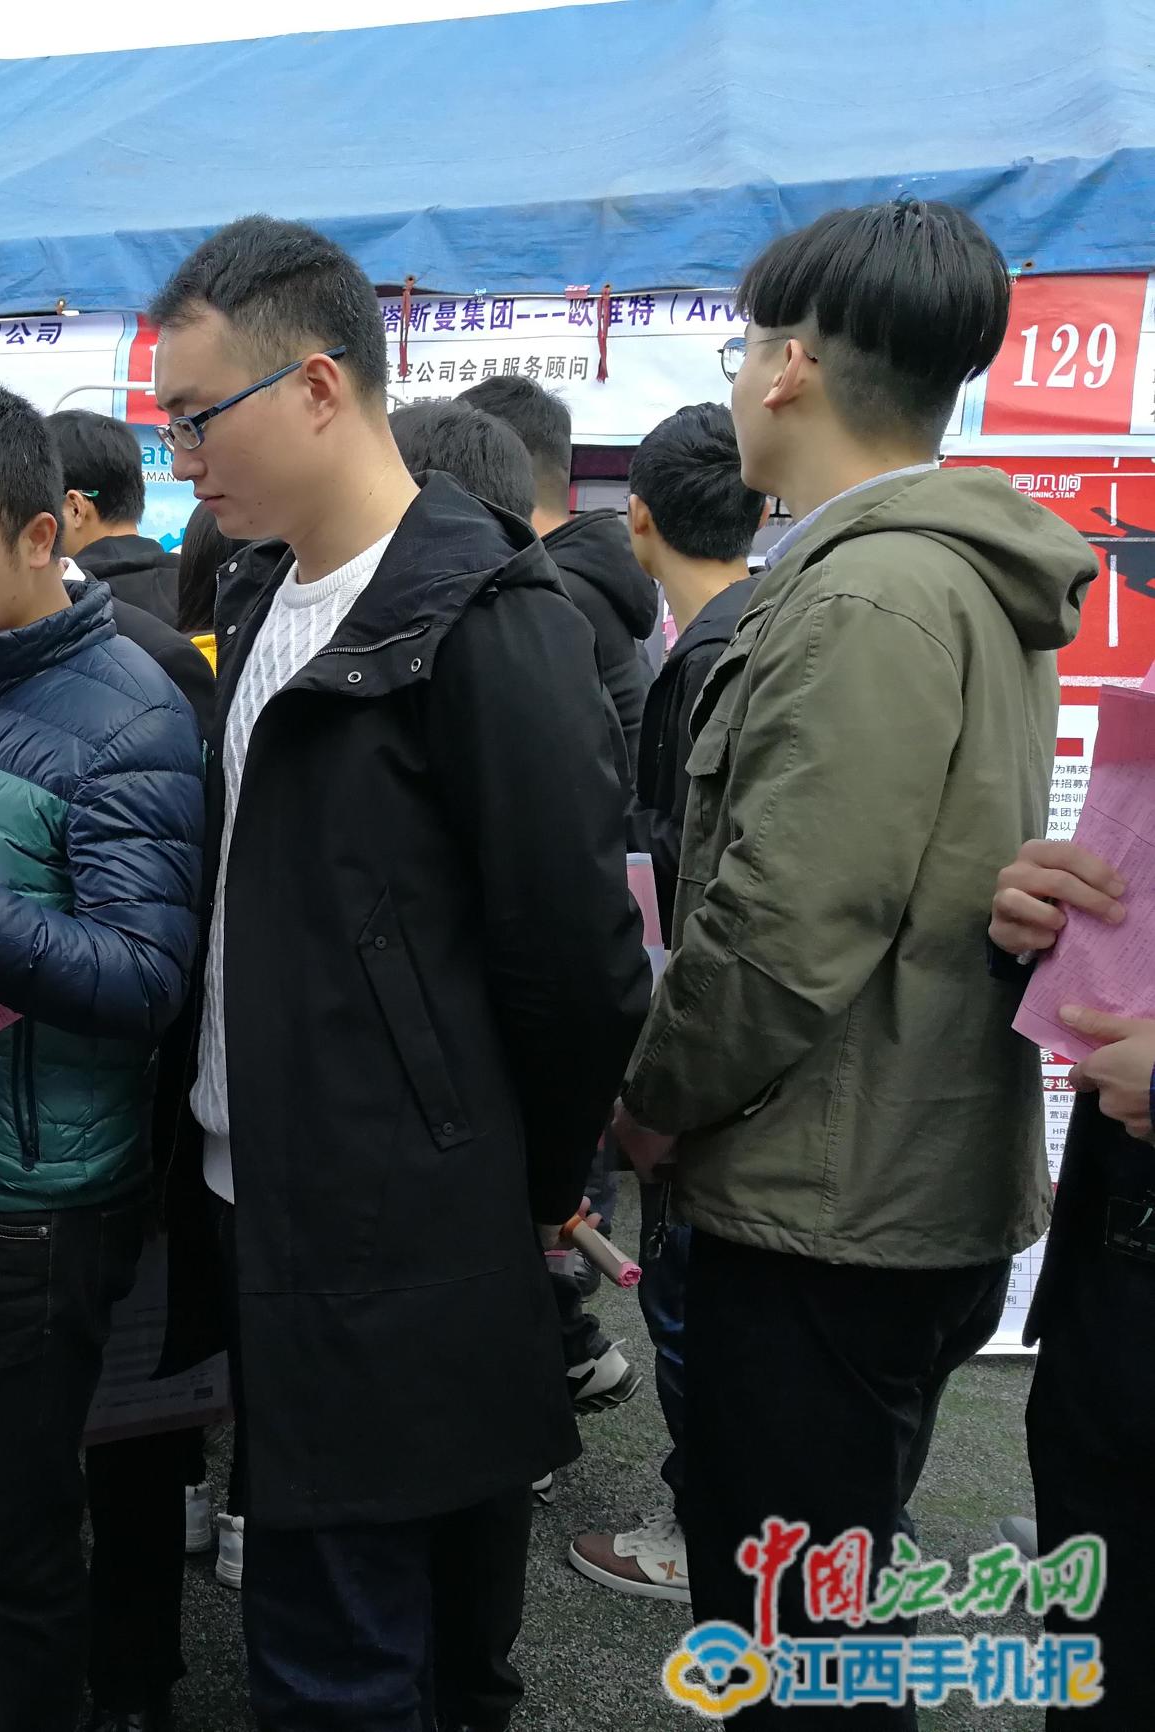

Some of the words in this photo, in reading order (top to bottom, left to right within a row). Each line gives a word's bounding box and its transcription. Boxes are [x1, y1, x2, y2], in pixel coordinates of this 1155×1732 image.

[1014, 323, 1117, 389] 129
[1008, 473, 1082, 492] 同凡响
[1055, 491, 1076, 499] STAR
